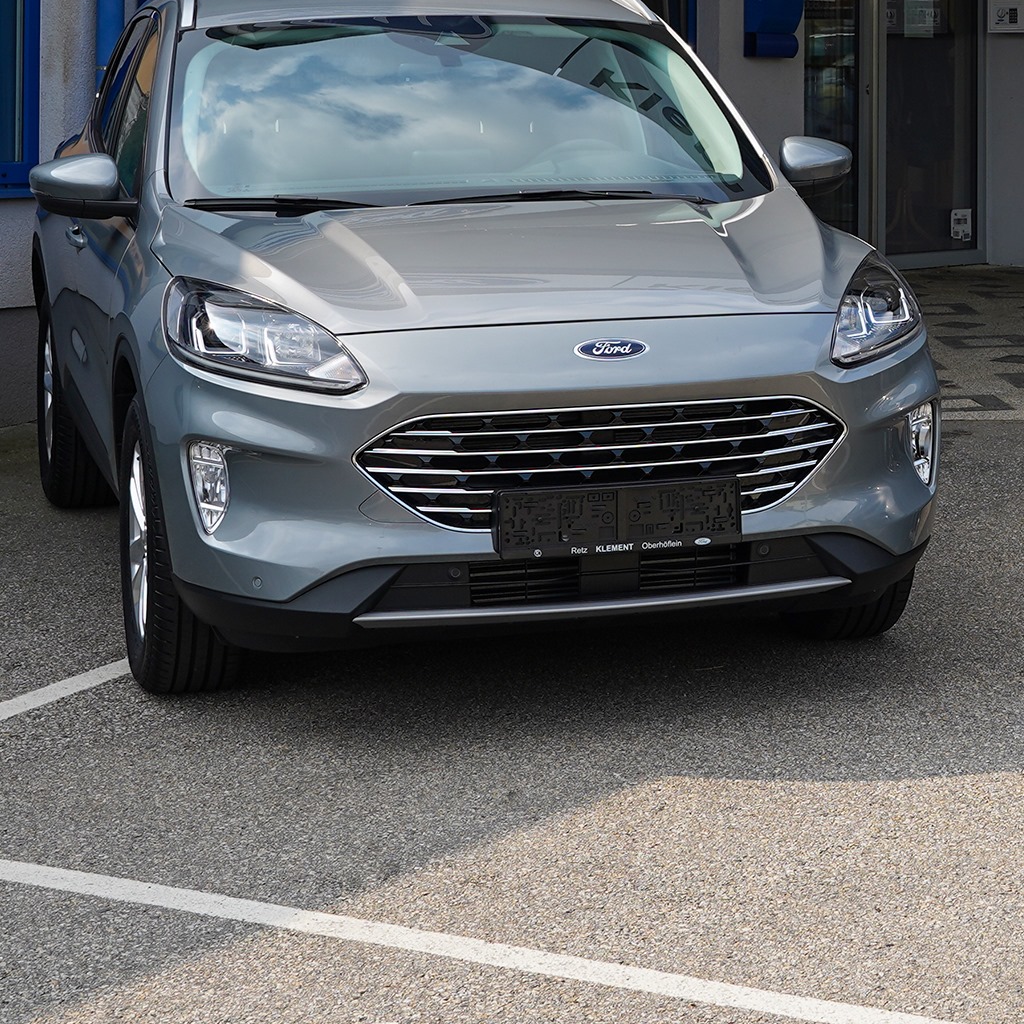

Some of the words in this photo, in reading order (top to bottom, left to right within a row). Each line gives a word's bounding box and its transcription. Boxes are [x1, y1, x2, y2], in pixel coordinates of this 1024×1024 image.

[592, 340, 632, 355] Ford
[570, 546, 588, 554] Retz
[595, 543, 634, 553] KLEMENT
[641, 539, 682, 551] Oberhöflein
